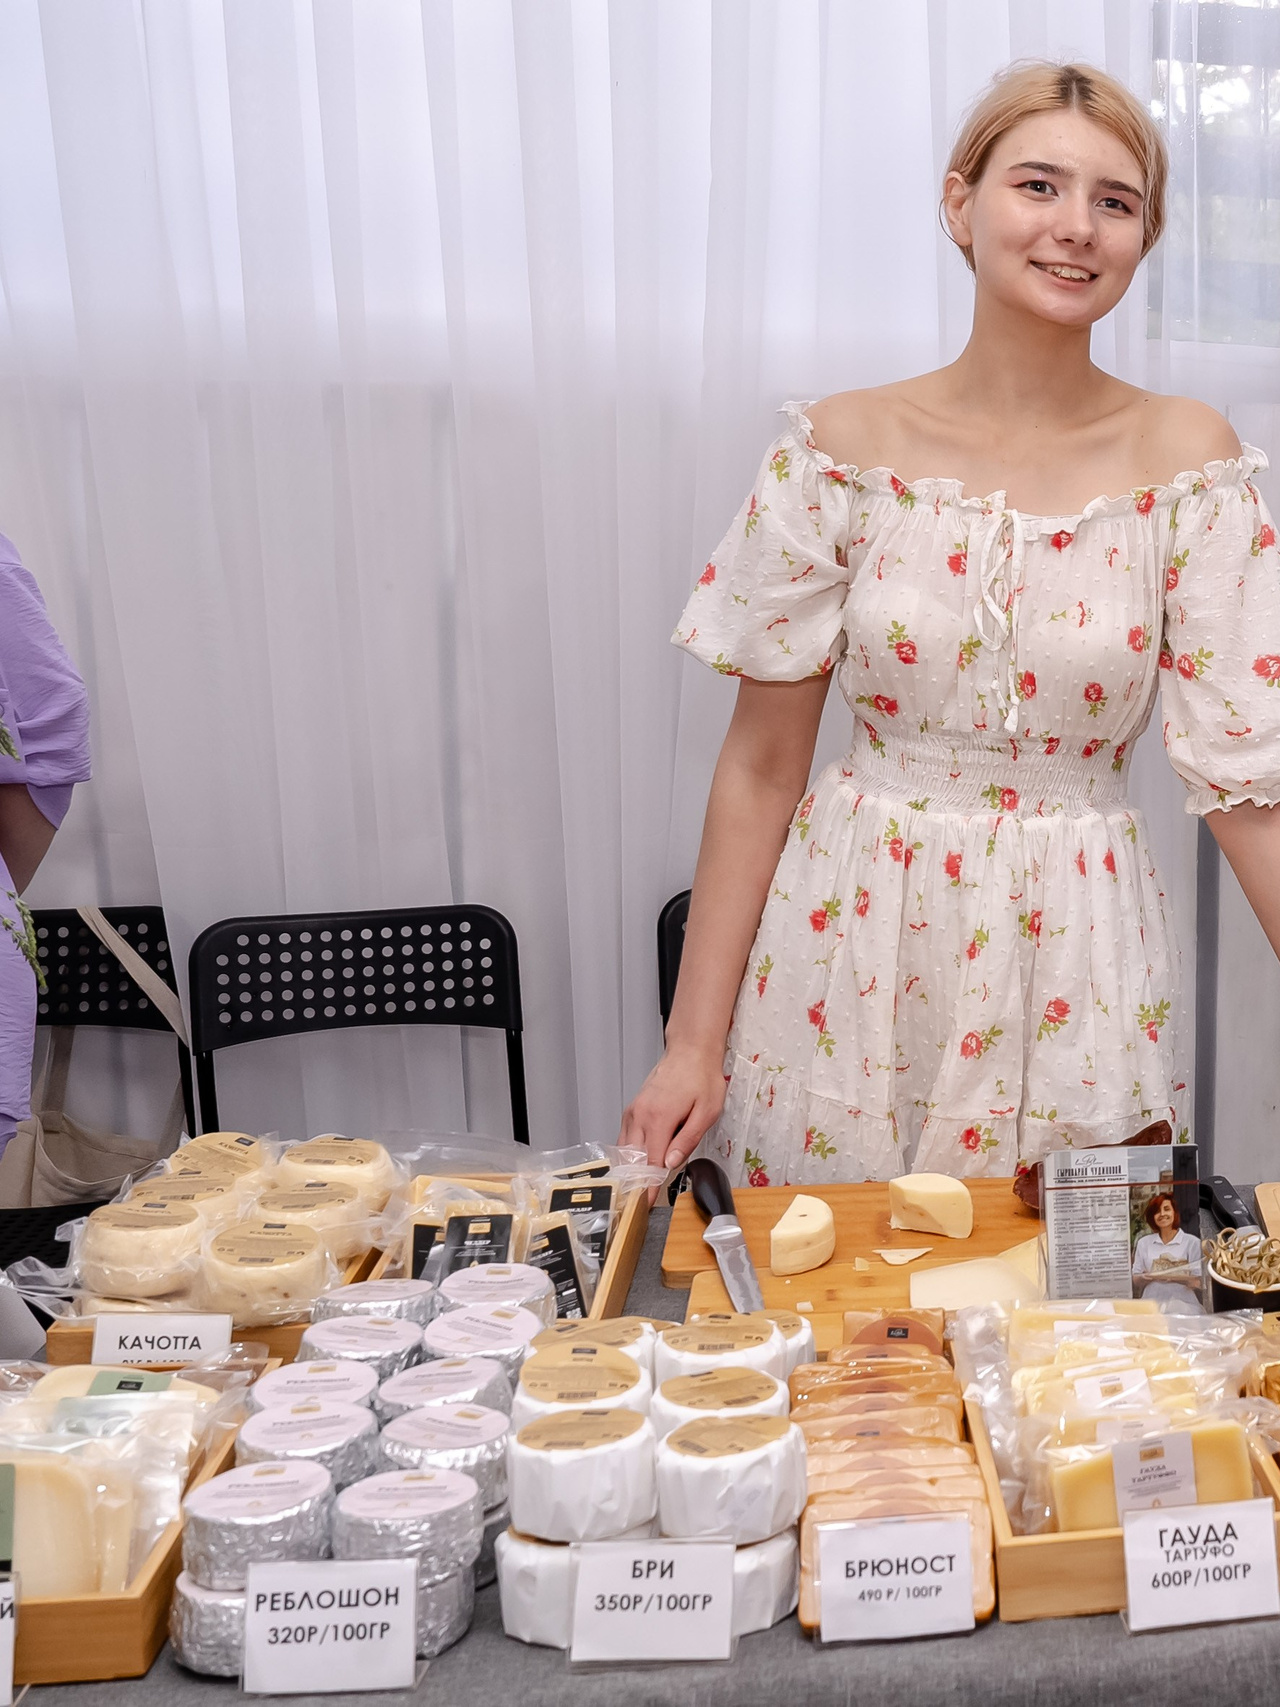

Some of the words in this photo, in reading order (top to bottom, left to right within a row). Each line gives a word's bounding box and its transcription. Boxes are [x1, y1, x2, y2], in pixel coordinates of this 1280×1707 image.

[118, 1335, 202, 1351] КАЧОТТА
[1158, 1521, 1239, 1548] ГАУДА
[1164, 1542, 1235, 1564] ТАРТУФО
[630, 1559, 675, 1580] БРИ
[844, 1553, 956, 1580] БРЮНОСТ
[1151, 1562, 1252, 1589] 600Р/100ГР
[254, 1586, 400, 1613] РЕБЛОШОН
[594, 1593, 713, 1614] 350Р/100ГР
[857, 1588, 883, 1601] 490
[905, 1584, 943, 1599] 100ГР
[266, 1622, 392, 1646] 320Р/100ГР
